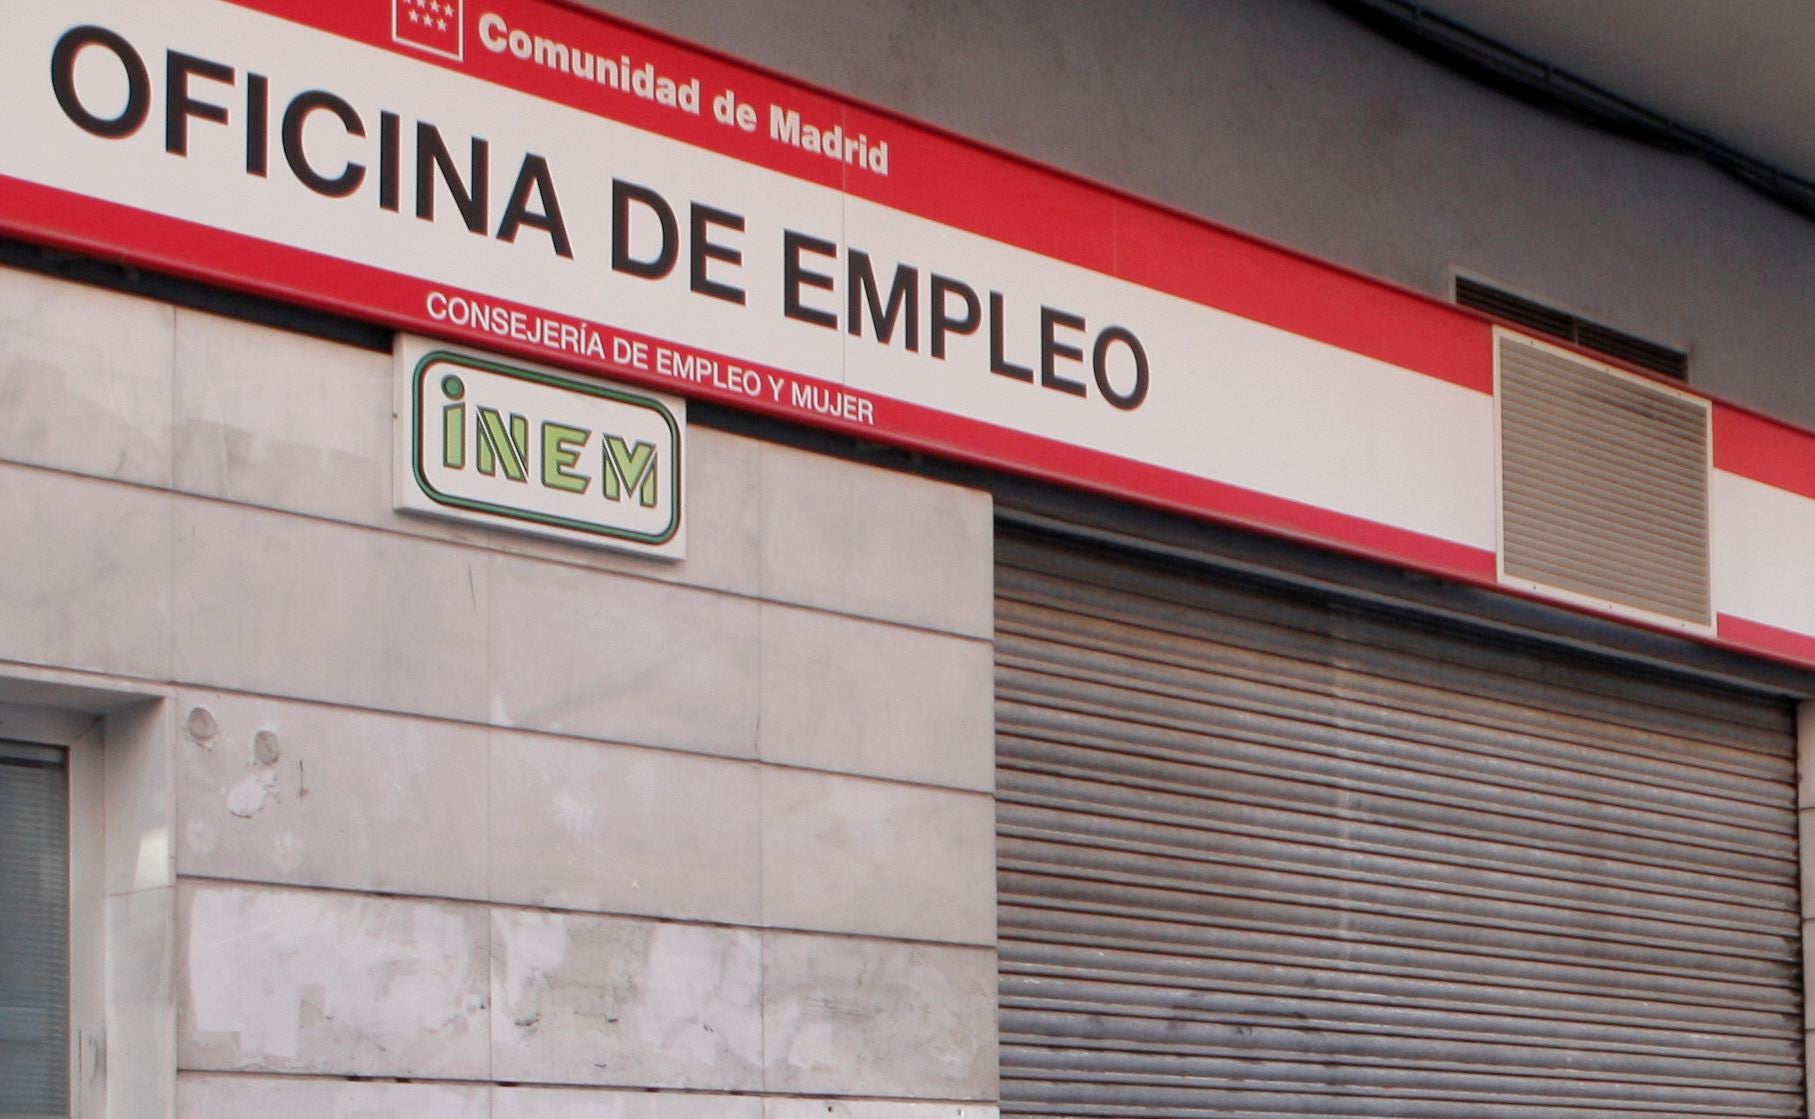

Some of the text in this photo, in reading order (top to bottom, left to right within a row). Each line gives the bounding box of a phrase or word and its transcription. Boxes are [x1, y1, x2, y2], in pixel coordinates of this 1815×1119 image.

[478, 13, 889, 176] Comunidad de Madrid
[50, 25, 1149, 411] OFICINA DE EMPLEO
[426, 291, 875, 425] CONSEJERÍA DE EMPLEO Y MUJER
